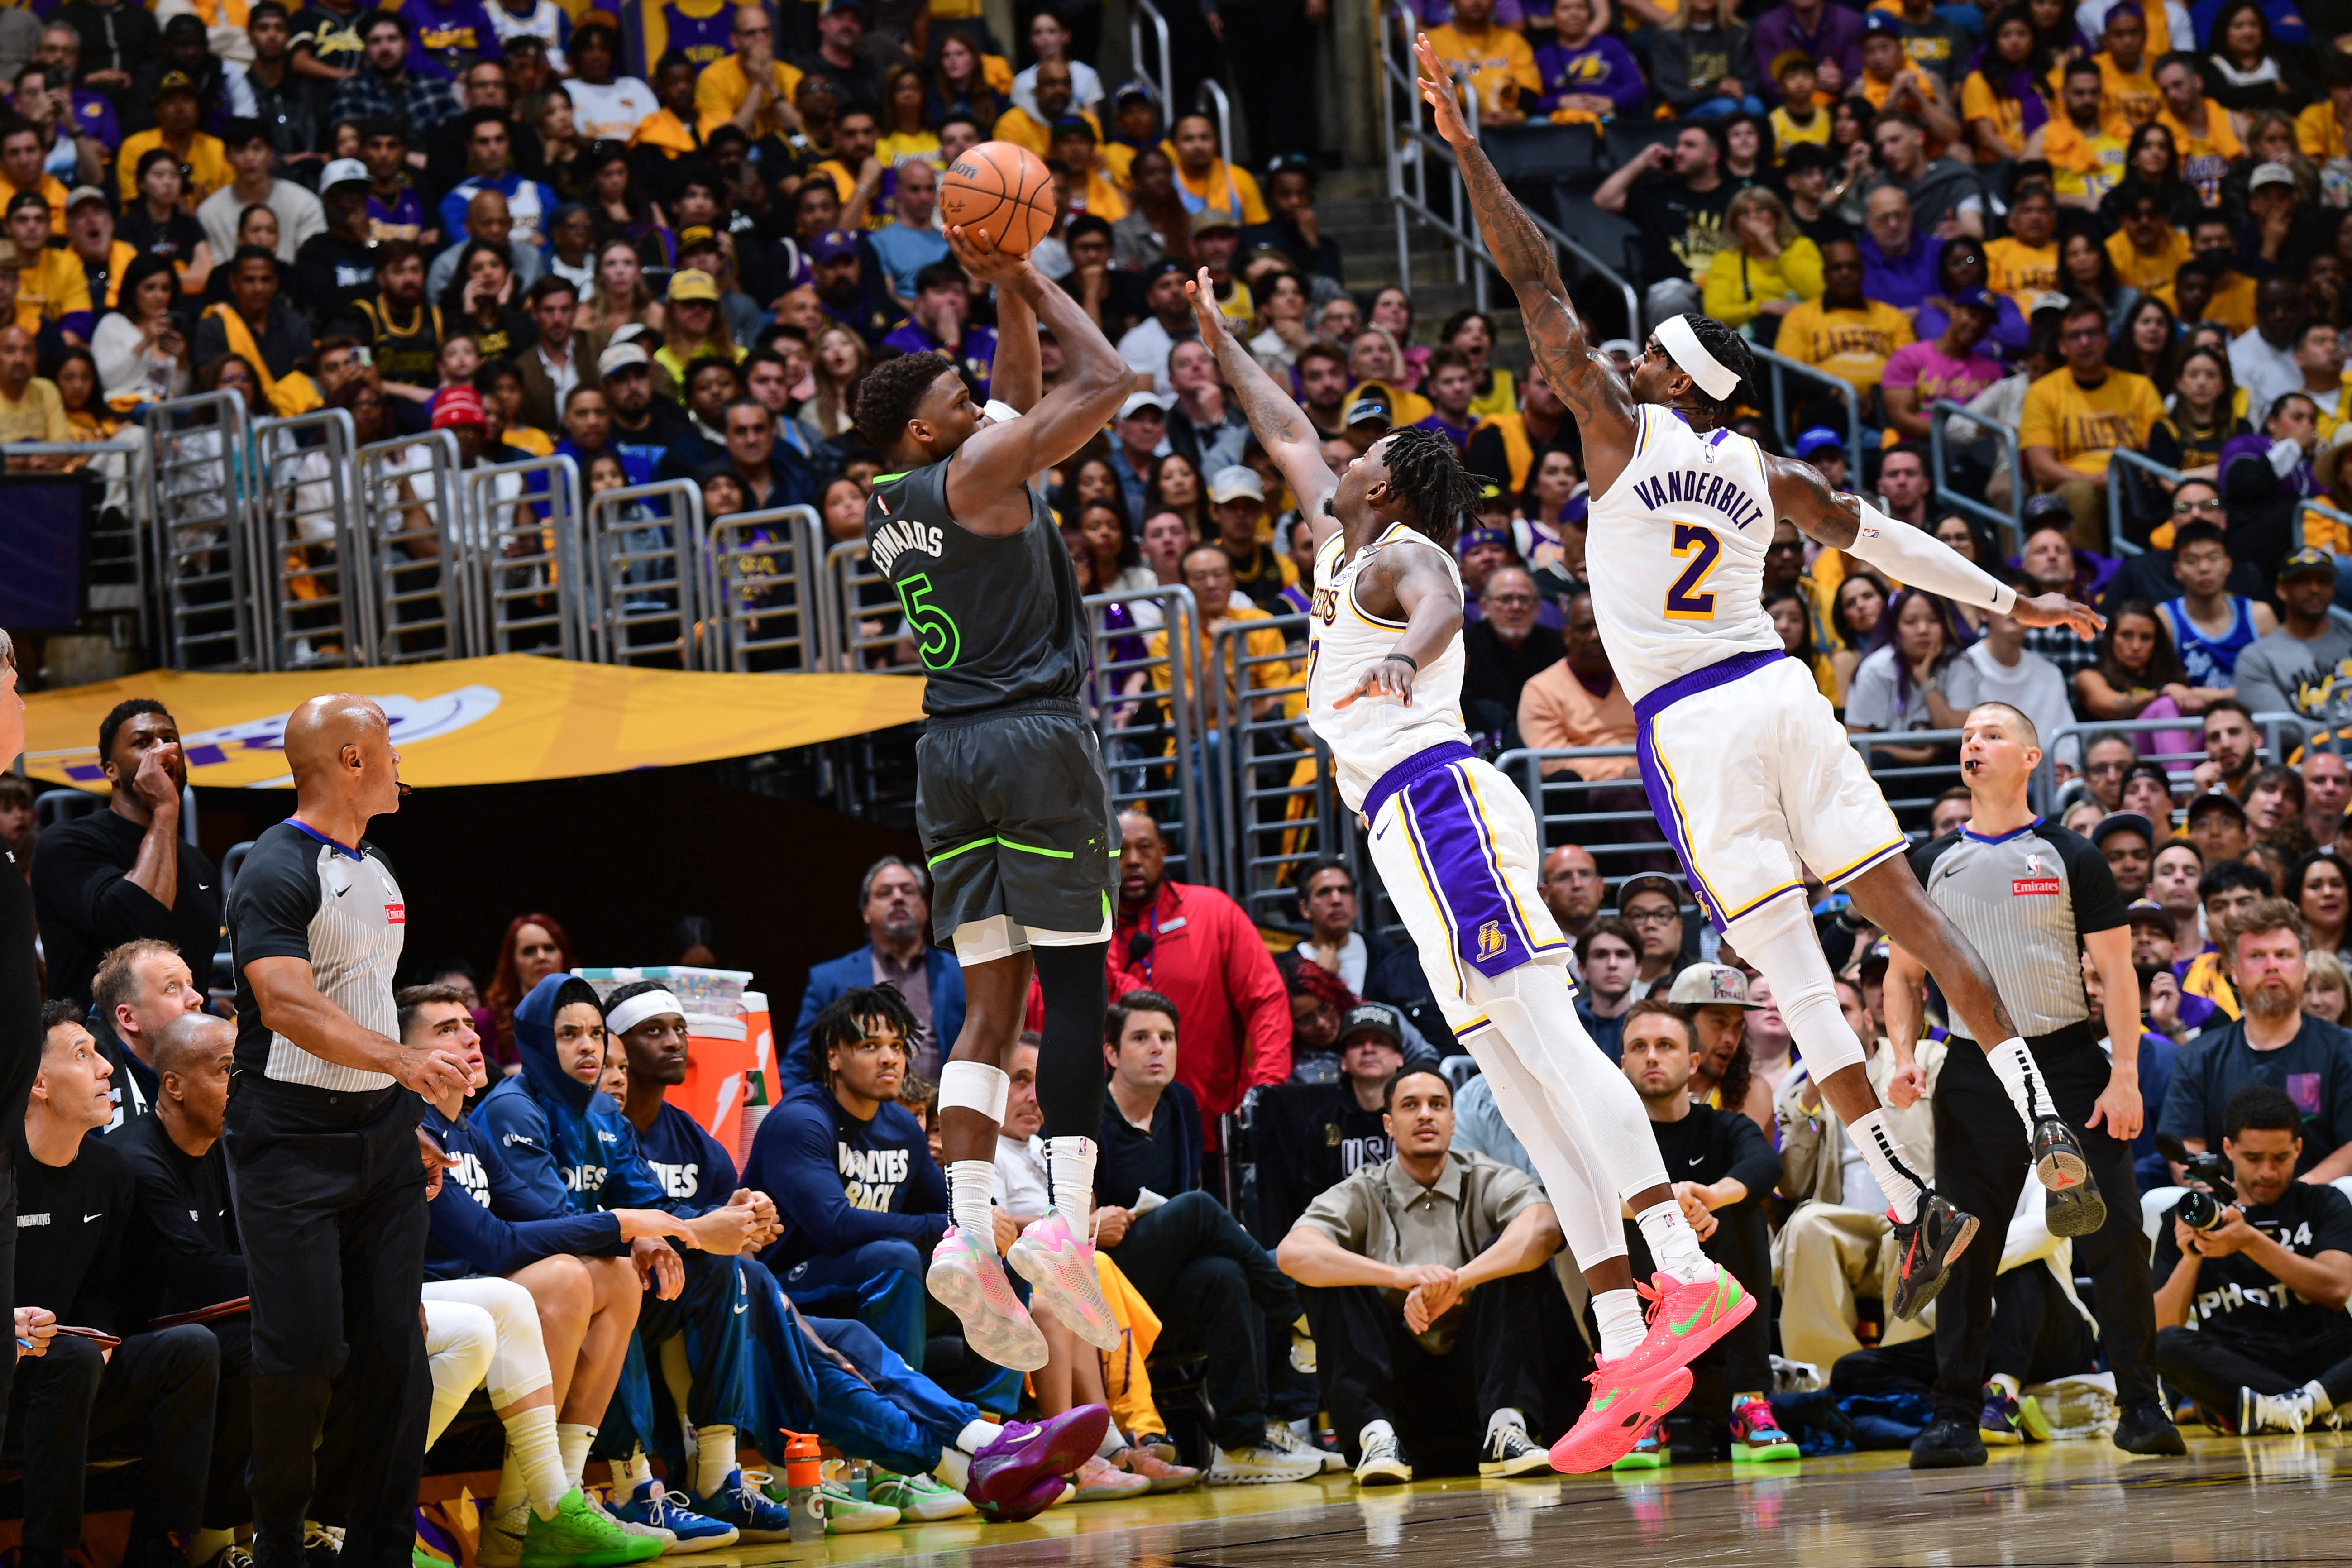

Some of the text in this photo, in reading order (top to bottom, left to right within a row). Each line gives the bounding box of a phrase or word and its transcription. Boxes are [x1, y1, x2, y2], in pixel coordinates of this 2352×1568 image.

[1633, 470, 1763, 531] VANDERBILT
[872, 520, 943, 579] EDWARDS
[1664, 521, 1723, 621] 2
[896, 572, 960, 670] 5
[2013, 881, 2059, 893] Emirates
[838, 1141, 909, 1183] WOLVES
[2279, 1220, 2314, 1253] 24
[2198, 1282, 2311, 1319] PHOT
